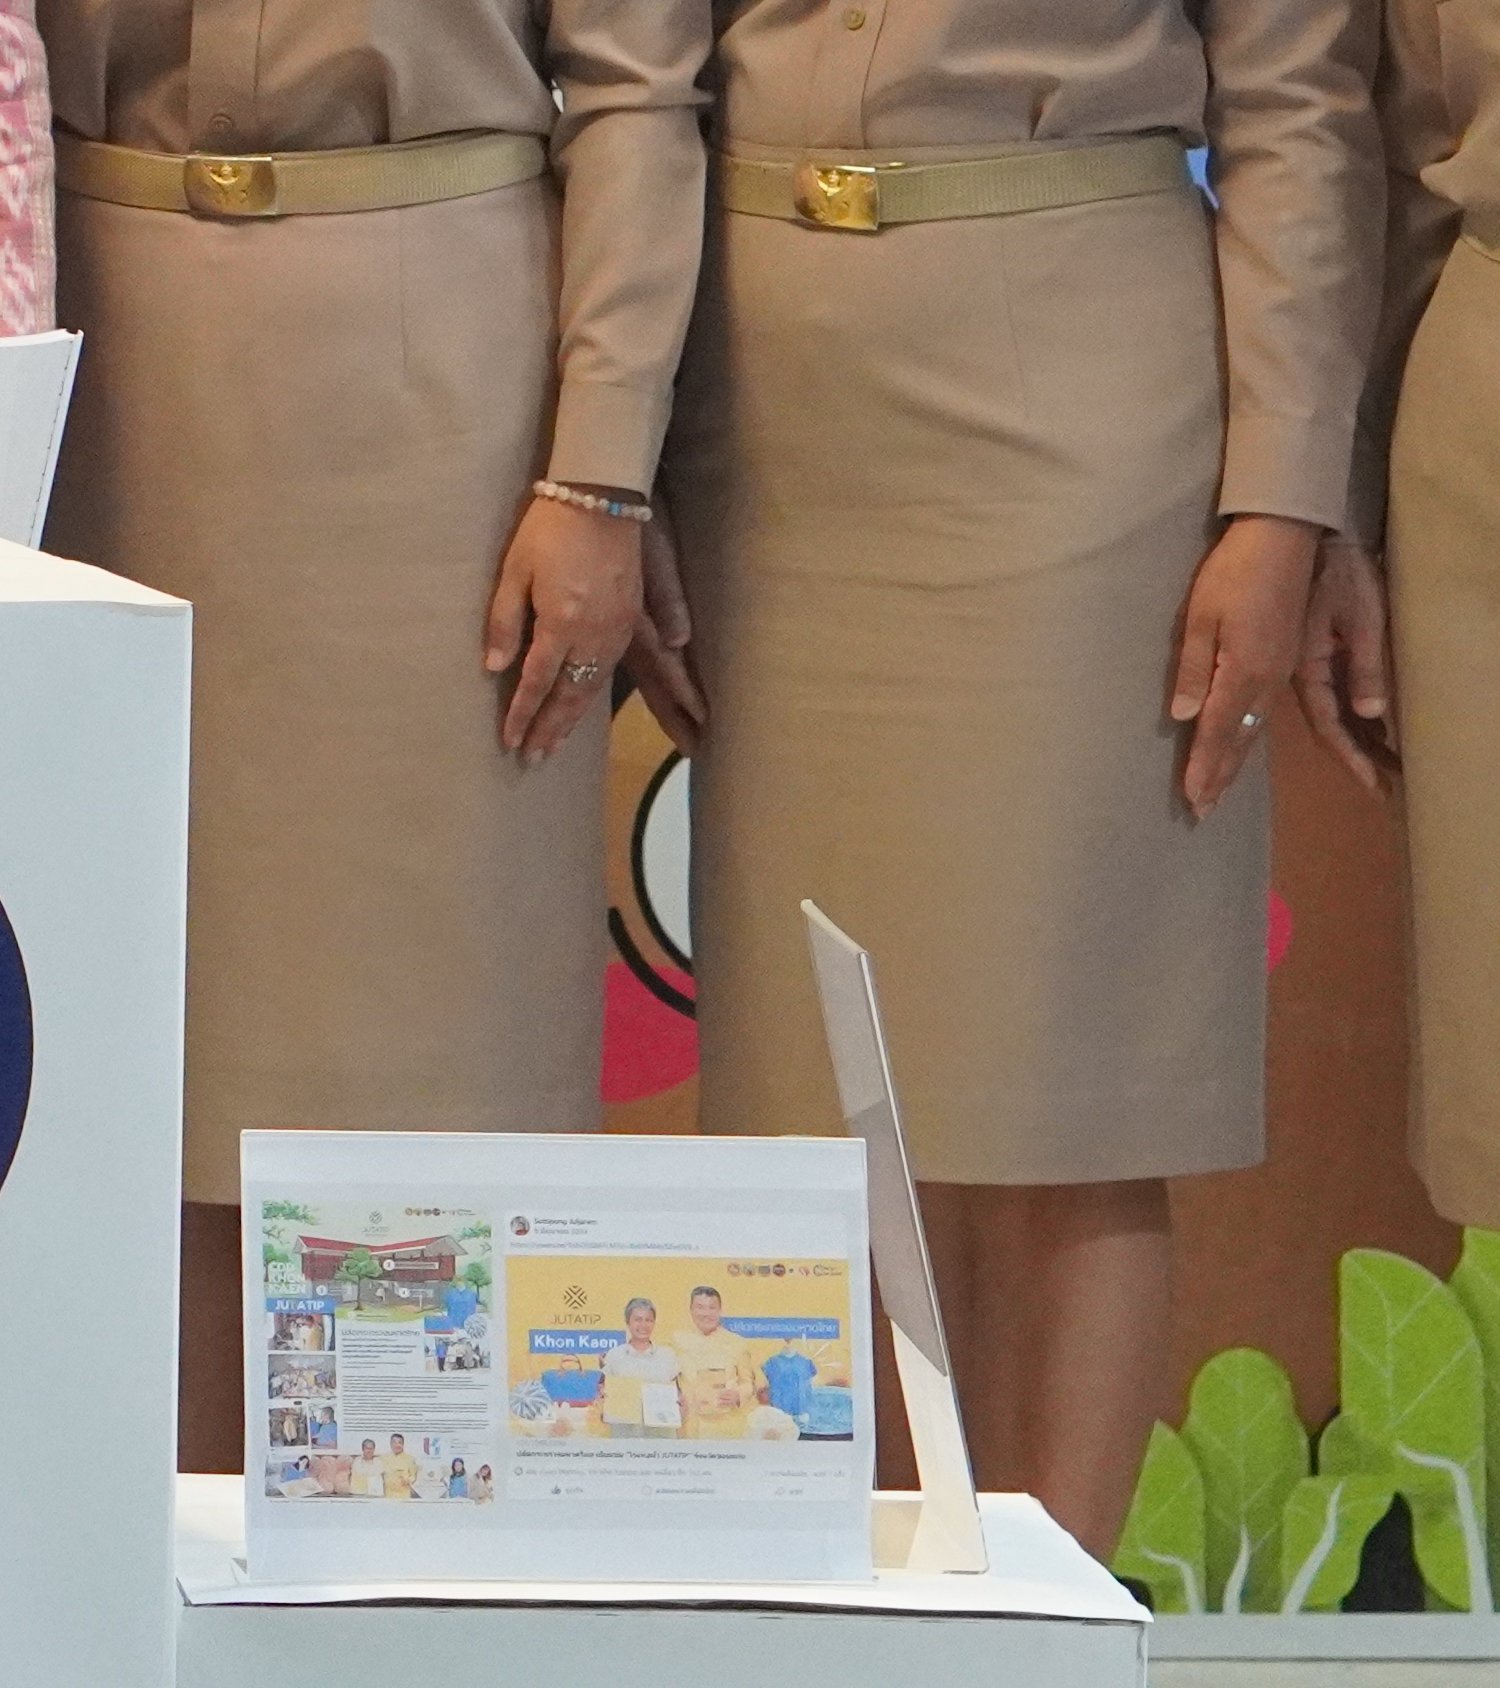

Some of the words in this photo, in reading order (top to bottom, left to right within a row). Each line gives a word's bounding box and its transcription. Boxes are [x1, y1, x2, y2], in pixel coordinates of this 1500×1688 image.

[551, 1314, 601, 1325] JUTATIP
[534, 1334, 575, 1348] Khon
[579, 1335, 619, 1349] Kaen
